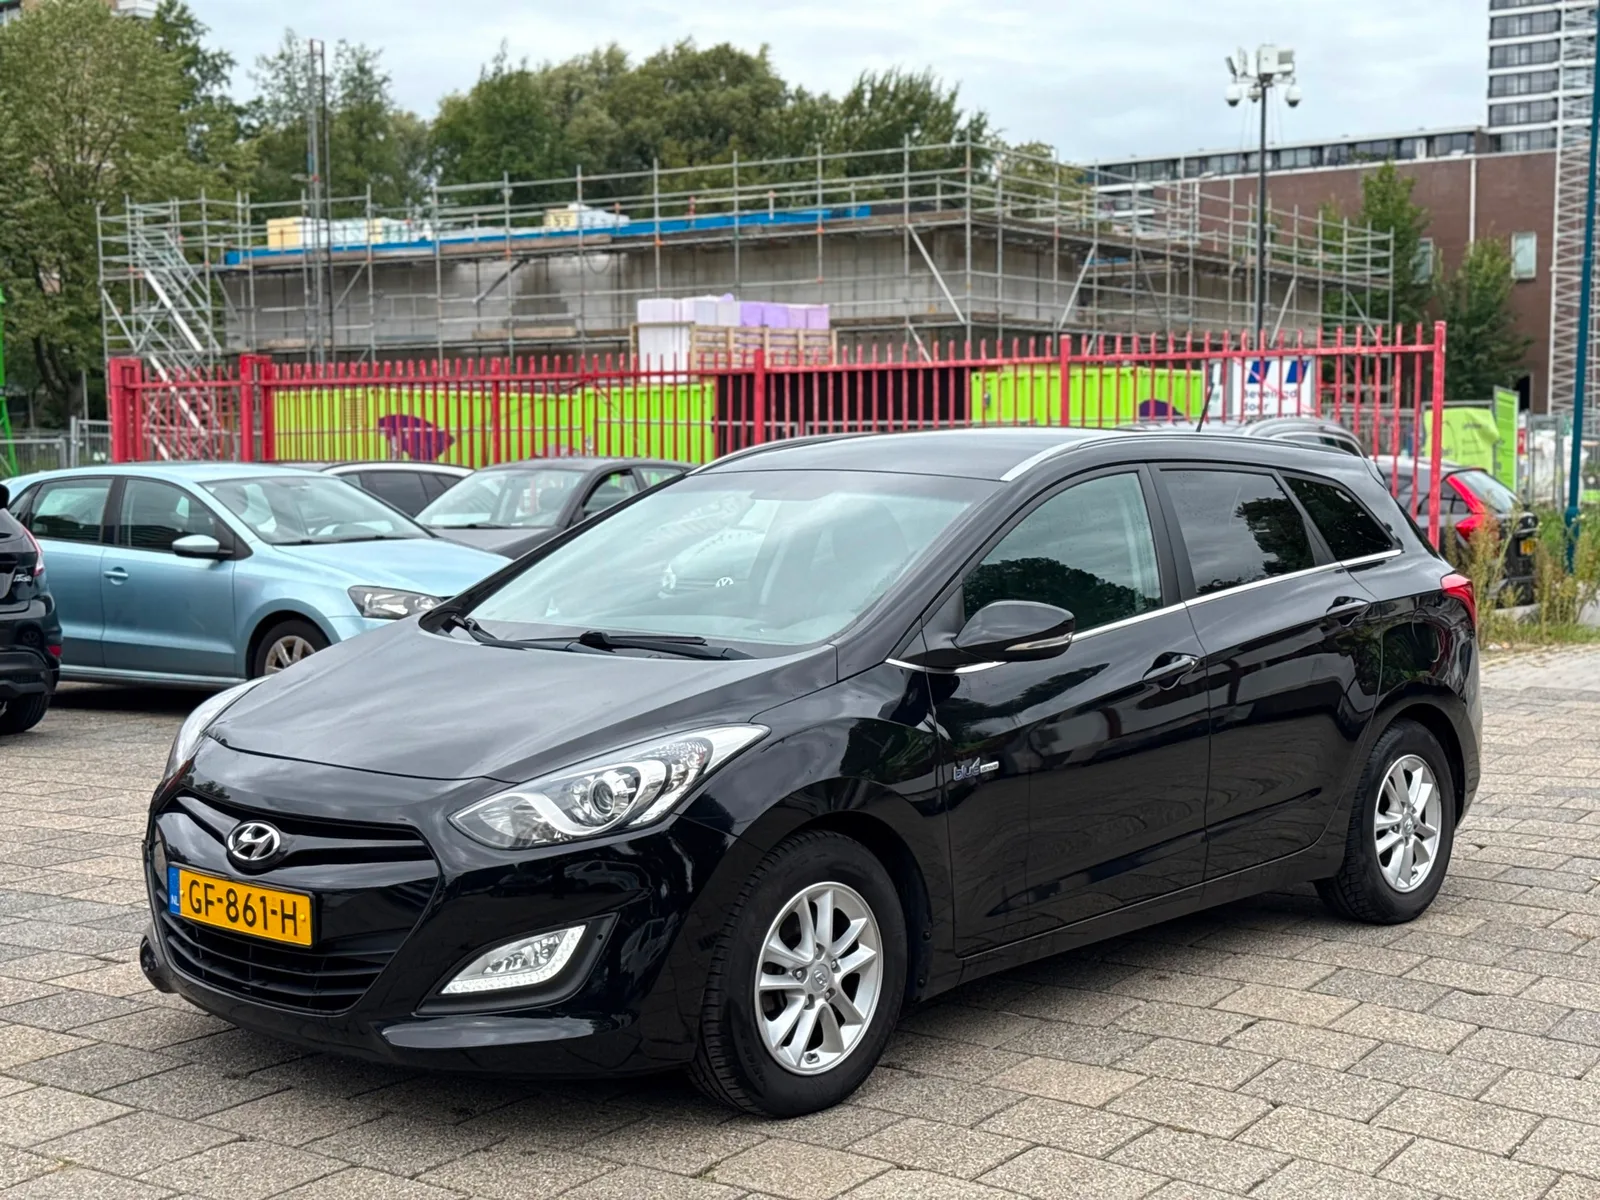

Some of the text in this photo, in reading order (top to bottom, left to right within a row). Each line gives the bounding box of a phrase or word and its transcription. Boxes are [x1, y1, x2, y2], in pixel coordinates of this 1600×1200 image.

[953, 761, 980, 781] blue
[170, 894, 180, 906] NL
[189, 879, 298, 936] GF-861-H
